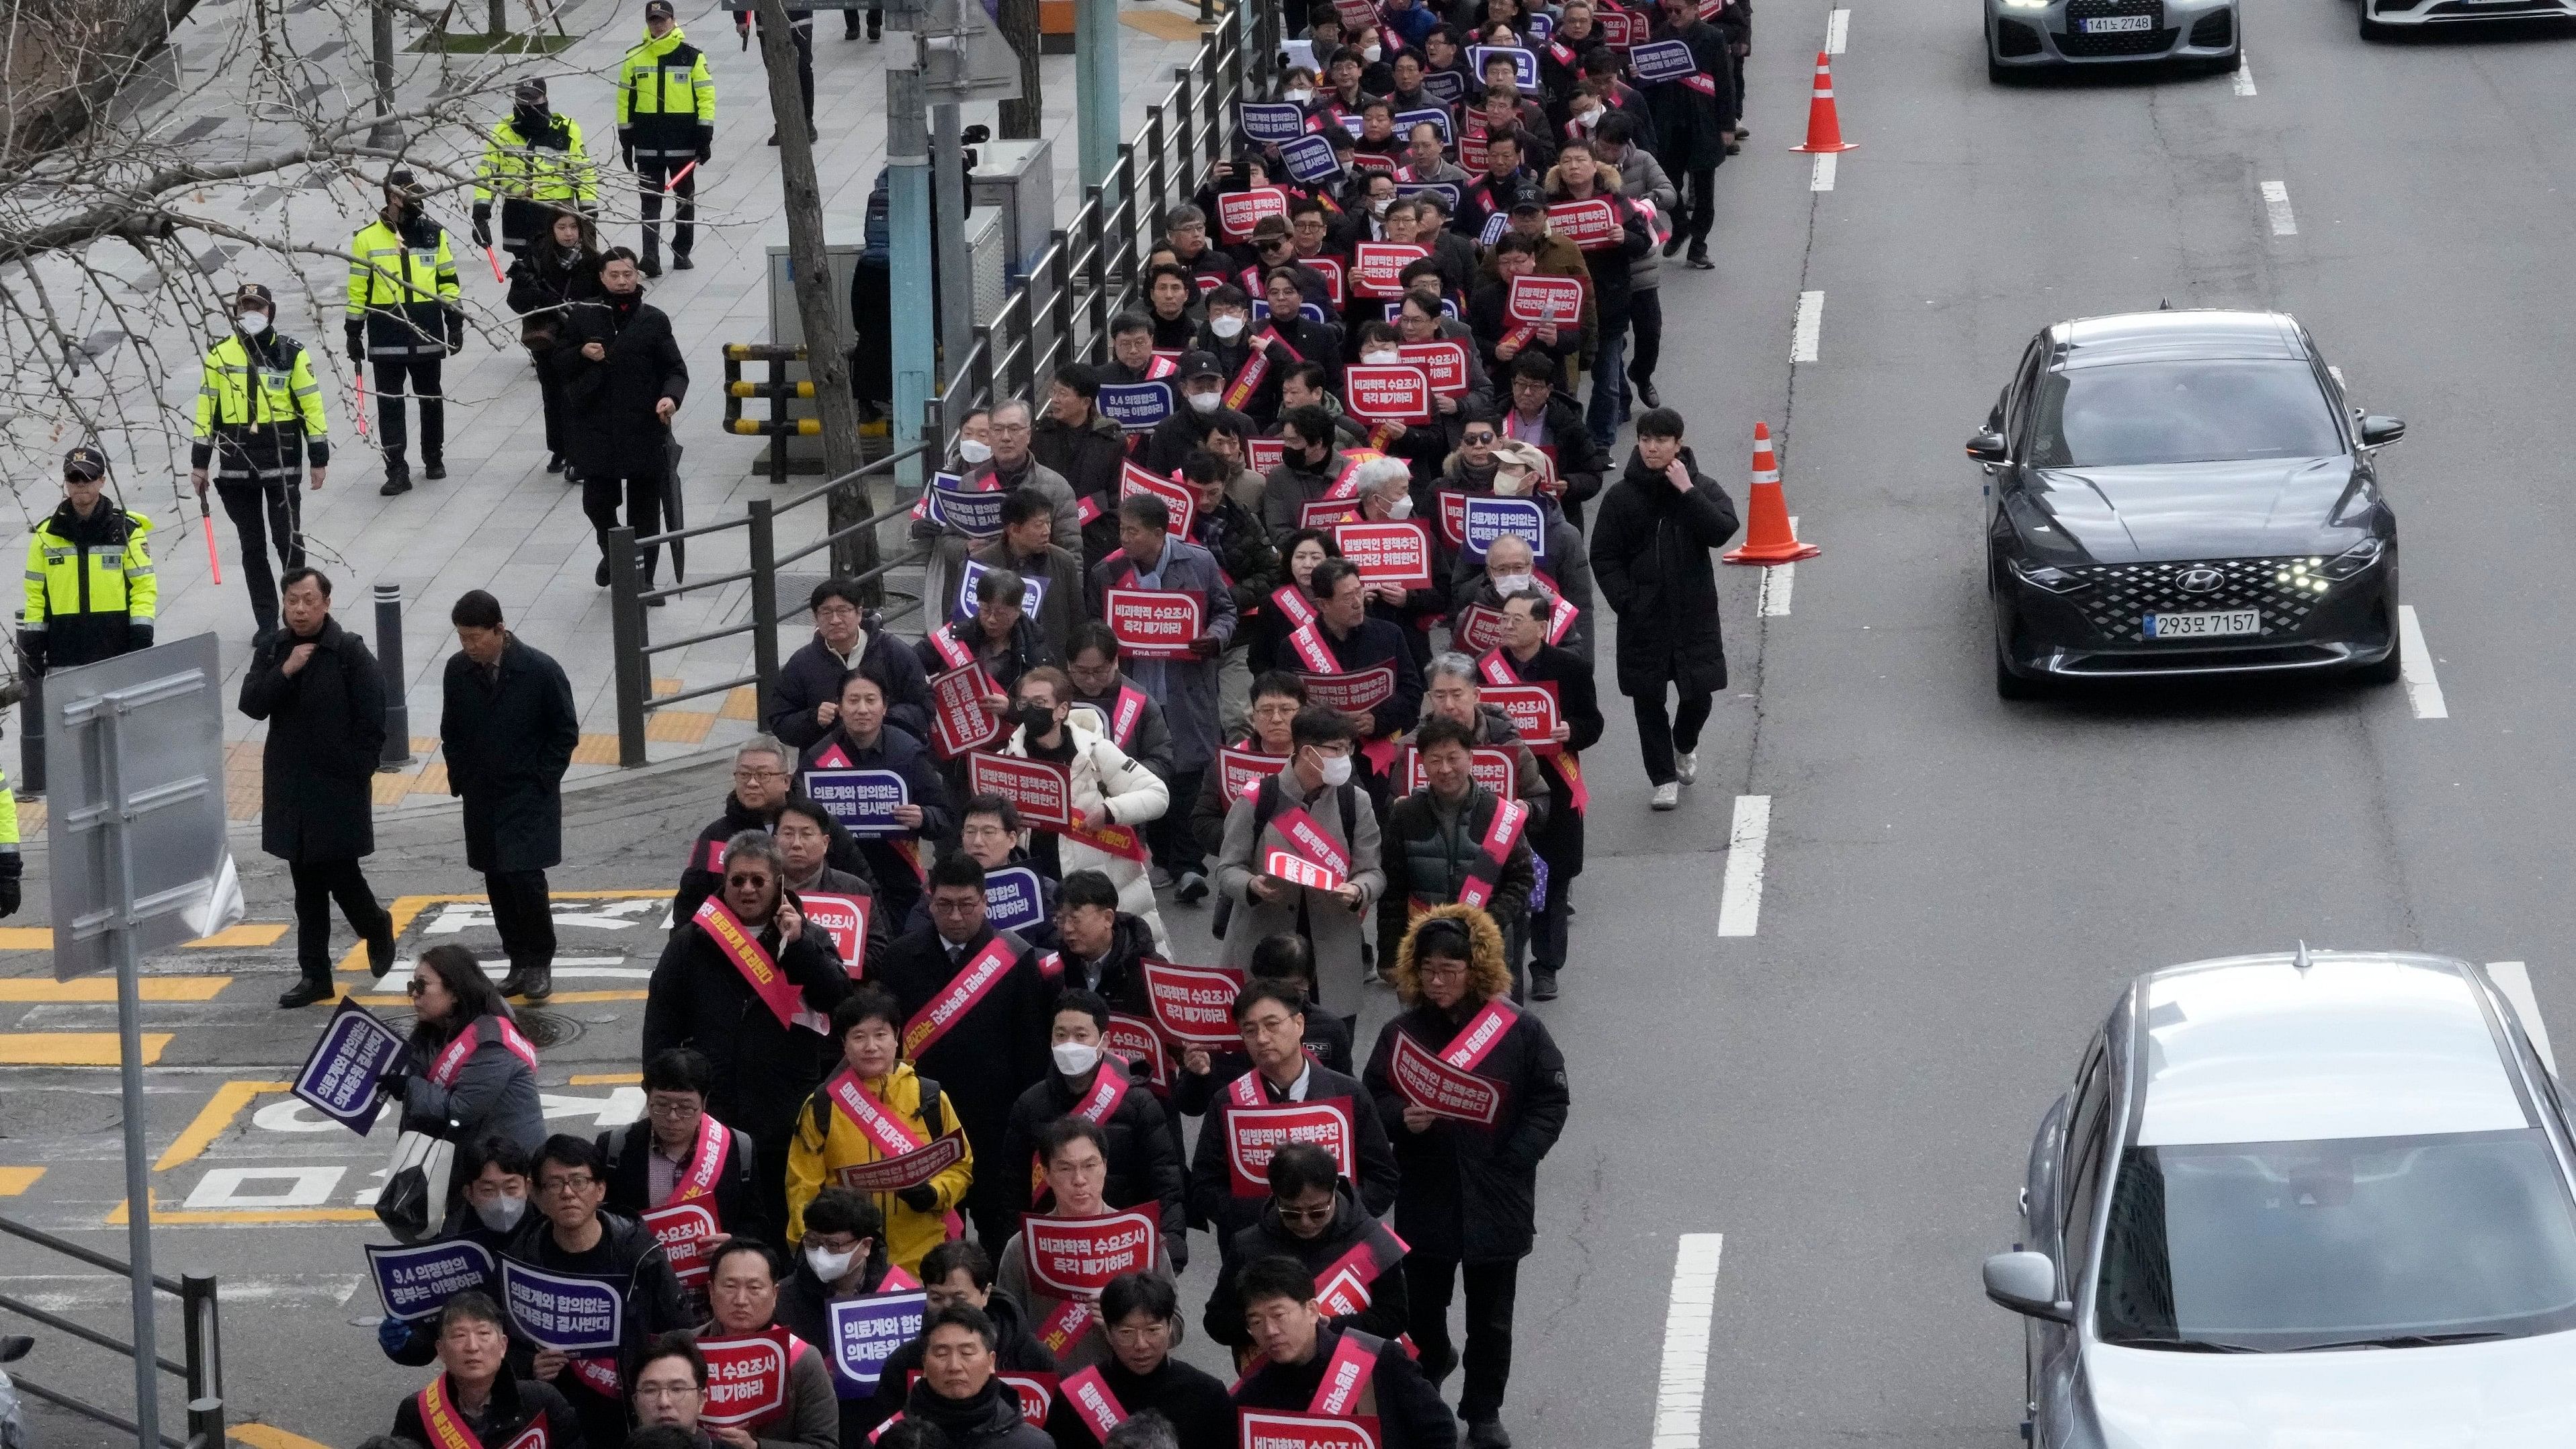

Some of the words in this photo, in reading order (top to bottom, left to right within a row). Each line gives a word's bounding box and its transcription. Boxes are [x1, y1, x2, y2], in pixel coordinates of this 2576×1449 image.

[2090, 20, 2117, 30] 141노
[2121, 17, 2148, 29] 2748
[1426, 353, 1459, 366] 수요조사
[1387, 378, 1422, 390] 수요조사
[1109, 396, 1123, 406] 9.4
[1363, 392, 1379, 404] 즉각
[1106, 406, 1129, 418] 정부는
[1131, 403, 1164, 417] 이행하라
[1471, 510, 1499, 525] 의료계와
[1499, 512, 1538, 527] 합의없는
[1343, 538, 1381, 552] 일방적인
[1382, 537, 1419, 550] 정책추진
[1382, 550, 1420, 566] 위협한다
[1115, 605, 1152, 617] 비과학적
[1154, 607, 1192, 621] 수요조사
[2159, 617, 2205, 634] 293모
[2210, 614, 2254, 631] 7157
[1123, 620, 1142, 633] 즉각
[1144, 622, 1182, 635] 폐기하라
[1507, 701, 1547, 715] 수요조사
[813, 785, 855, 799] 의료계와
[857, 785, 899, 799] 합의없는
[979, 767, 1018, 783] 일방적인
[1019, 775, 1058, 793] 정책추진
[1020, 791, 1059, 808] 위협한다
[1292, 821, 1330, 857] 일방적인
[809, 912, 855, 930] 수요조사
[738, 945, 775, 985] 붕괴된다
[963, 955, 1001, 993] 일방적인
[930, 987, 970, 1025] 정책추진
[1154, 983, 1189, 1003] 비과학적
[1191, 989, 1235, 1005] 수요조사
[1166, 1003, 1183, 1021] 즉각
[1185, 1006, 1228, 1024] 폐기하라
[1113, 1032, 1153, 1052] 수요조사
[316, 1054, 351, 1099] 의료계와
[340, 1020, 371, 1059] 합의없는
[333, 1063, 368, 1108] 의대증원
[356, 1030, 386, 1068] 결사반대
[839, 1082, 877, 1124] 의대정원
[874, 1116, 914, 1155] 확대추진
[1238, 1128, 1287, 1149] 일방적인
[1289, 1121, 1339, 1144] 정책추진
[655, 1219, 706, 1245] 수요조사
[1039, 1237, 1091, 1256] 비과학적
[1094, 1228, 1145, 1255] 수요조사
[392, 1267, 415, 1284] 9.4
[415, 1256, 469, 1281] 의정합의
[1054, 1258, 1080, 1274] 즉각
[1082, 1251, 1134, 1276] 폐기하라
[391, 1284, 431, 1305] 정부는
[432, 1272, 484, 1295] 이행하라
[511, 1280, 555, 1310] 의료계와
[557, 1294, 611, 1315] 합의없는
[512, 1299, 554, 1331] 의대증원
[556, 1315, 611, 1333] 결사반대
[844, 1317, 899, 1341] 의료계와
[722, 1354, 776, 1380] 수요조사
[710, 1378, 763, 1405] 폐기하라
[1322, 1360, 1361, 1415] 일방적인
[1078, 1380, 1119, 1432] 일방적인
